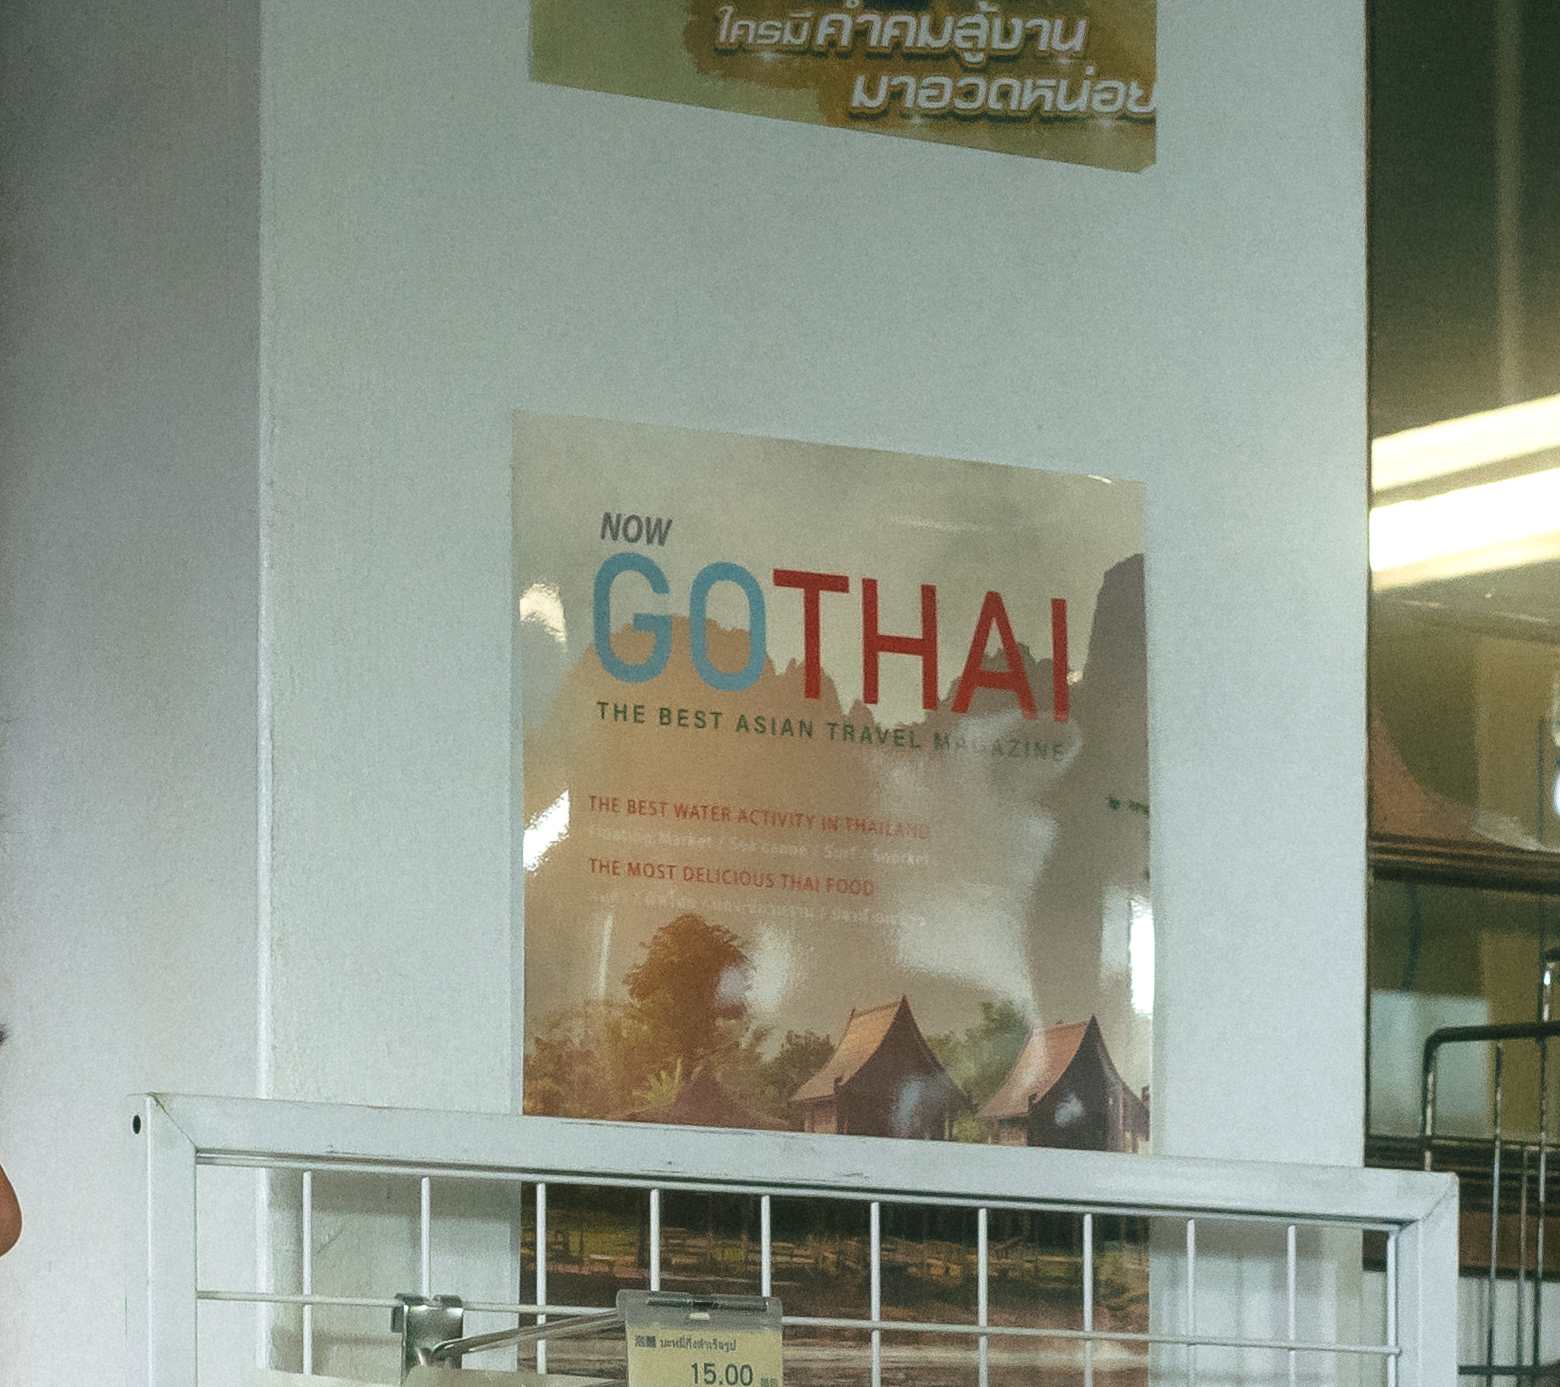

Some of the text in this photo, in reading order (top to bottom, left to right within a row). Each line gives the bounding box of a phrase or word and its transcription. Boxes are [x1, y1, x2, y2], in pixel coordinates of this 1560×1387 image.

[601, 511, 672, 547] NOW
[596, 701, 645, 725] THE
[659, 706, 723, 732] BEST
[735, 714, 814, 741] ASIAN
[826, 721, 921, 751] TRAVEL
[588, 795, 619, 812] THE
[627, 799, 668, 818] BEST
[674, 803, 731, 823] WATER
[738, 807, 815, 831] ACTIVITY
[822, 816, 838, 832] IN
[589, 859, 875, 896] THE MOST DELICIOUS THAI FOOD
[691, 1362, 754, 1387] 15.00
